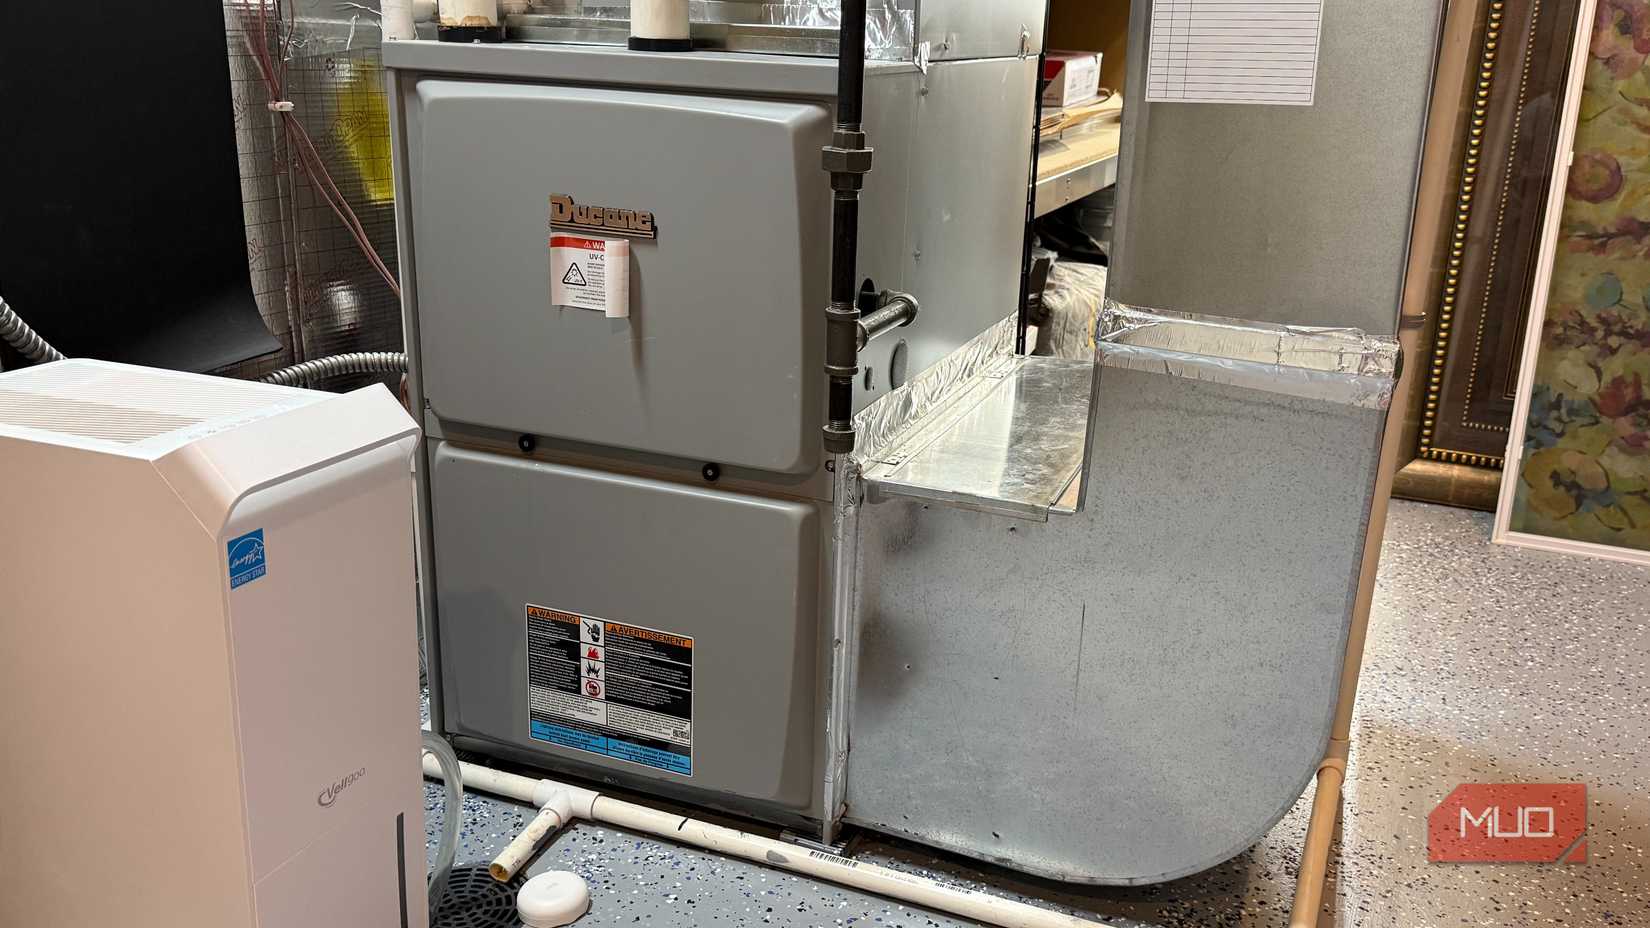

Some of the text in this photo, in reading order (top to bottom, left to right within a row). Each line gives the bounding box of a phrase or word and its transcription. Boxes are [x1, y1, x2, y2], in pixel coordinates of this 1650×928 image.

[550, 194, 652, 231] Ducane
[231, 566, 265, 587] ENERGY STAR
[537, 609, 577, 624] WARNING
[618, 625, 688, 647] AVERTISSEMENT
